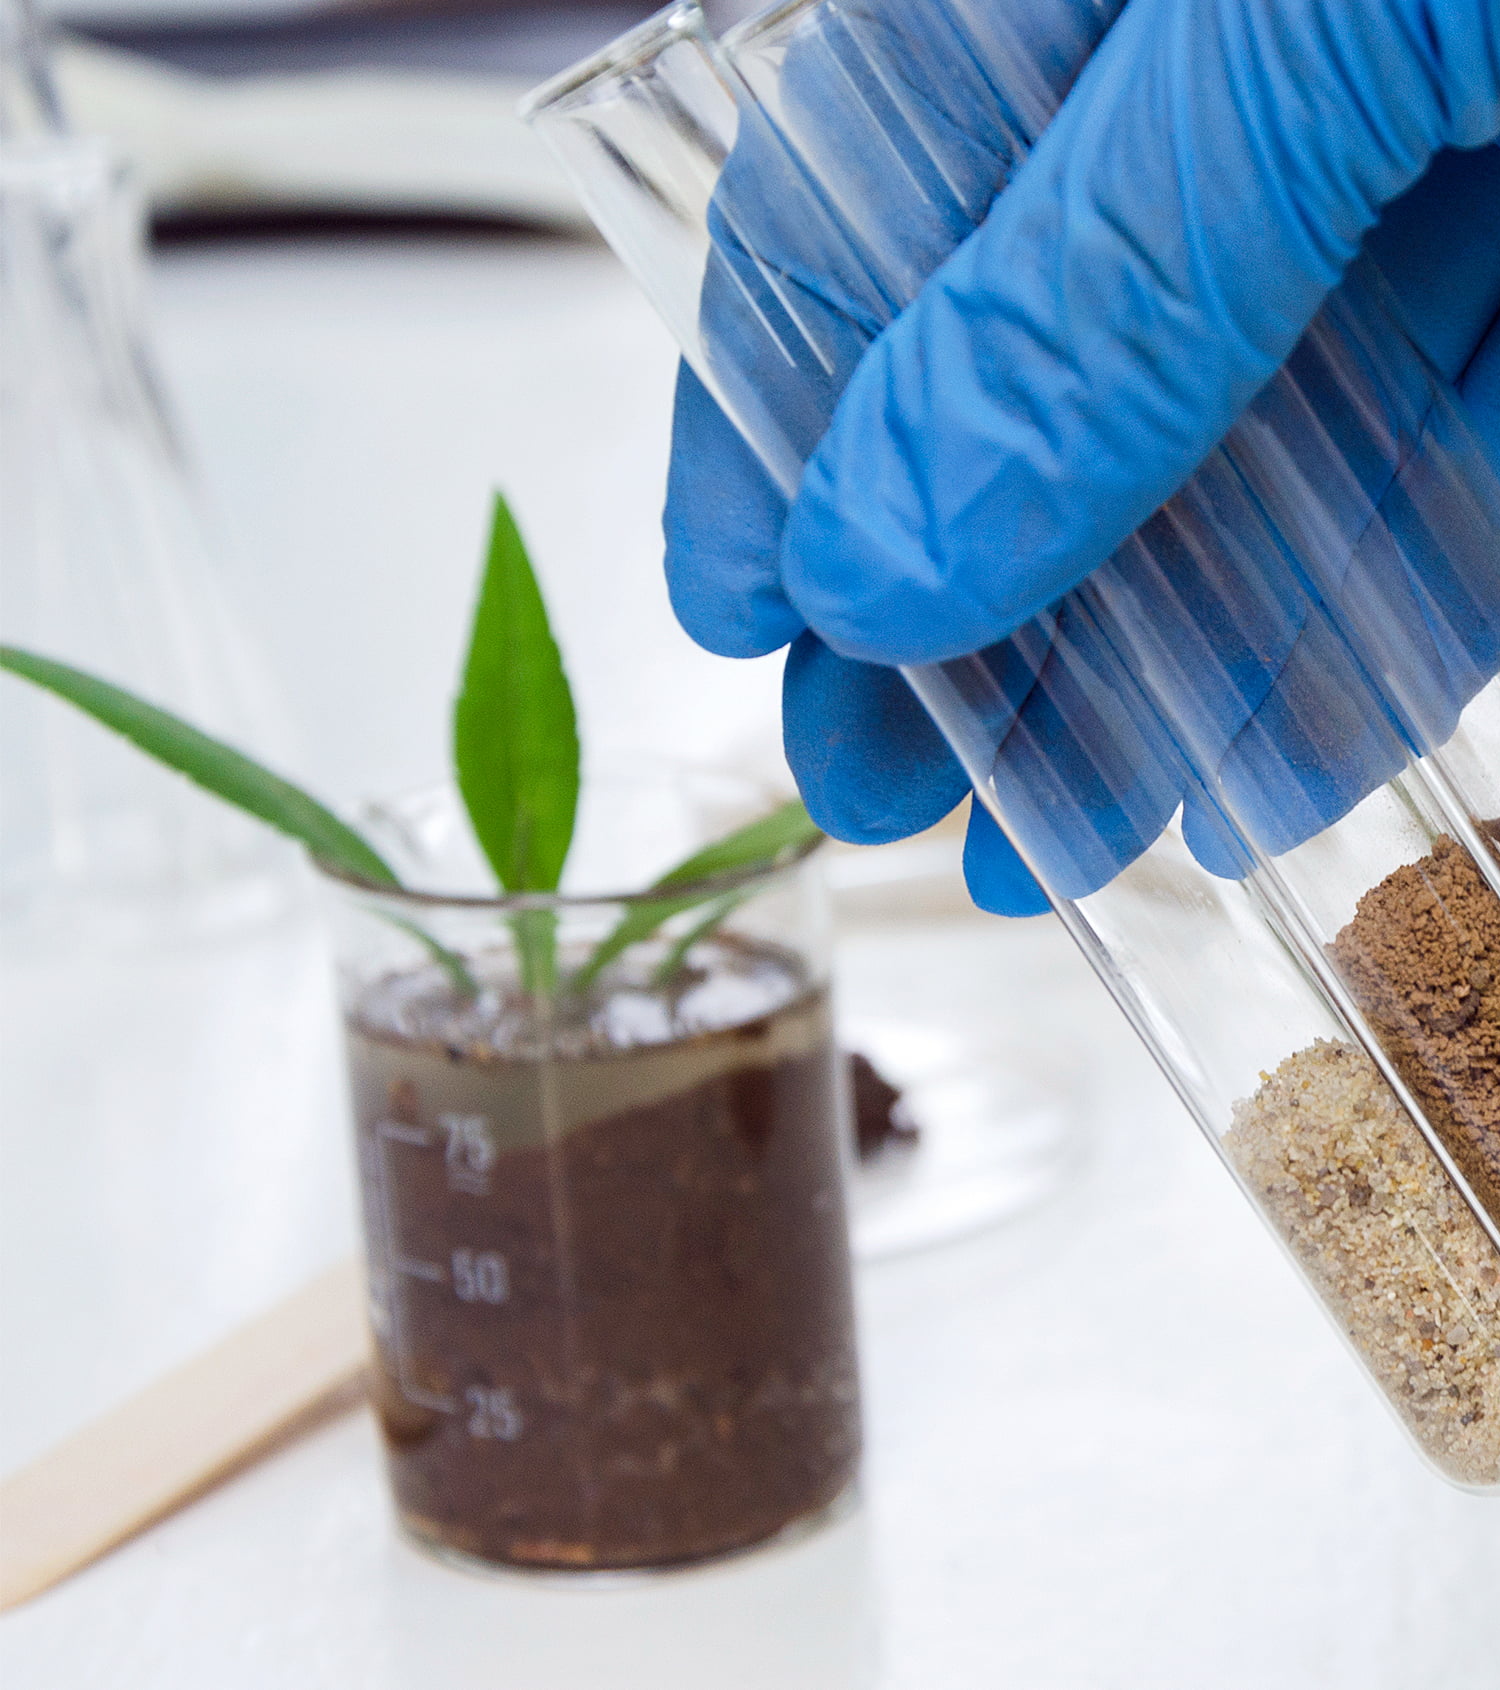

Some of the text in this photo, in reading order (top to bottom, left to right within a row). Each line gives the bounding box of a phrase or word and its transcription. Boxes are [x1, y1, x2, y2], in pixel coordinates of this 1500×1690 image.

[438, 1113, 496, 1170] 75
[451, 1249, 509, 1304] 50
[466, 1386, 523, 1441] 25
